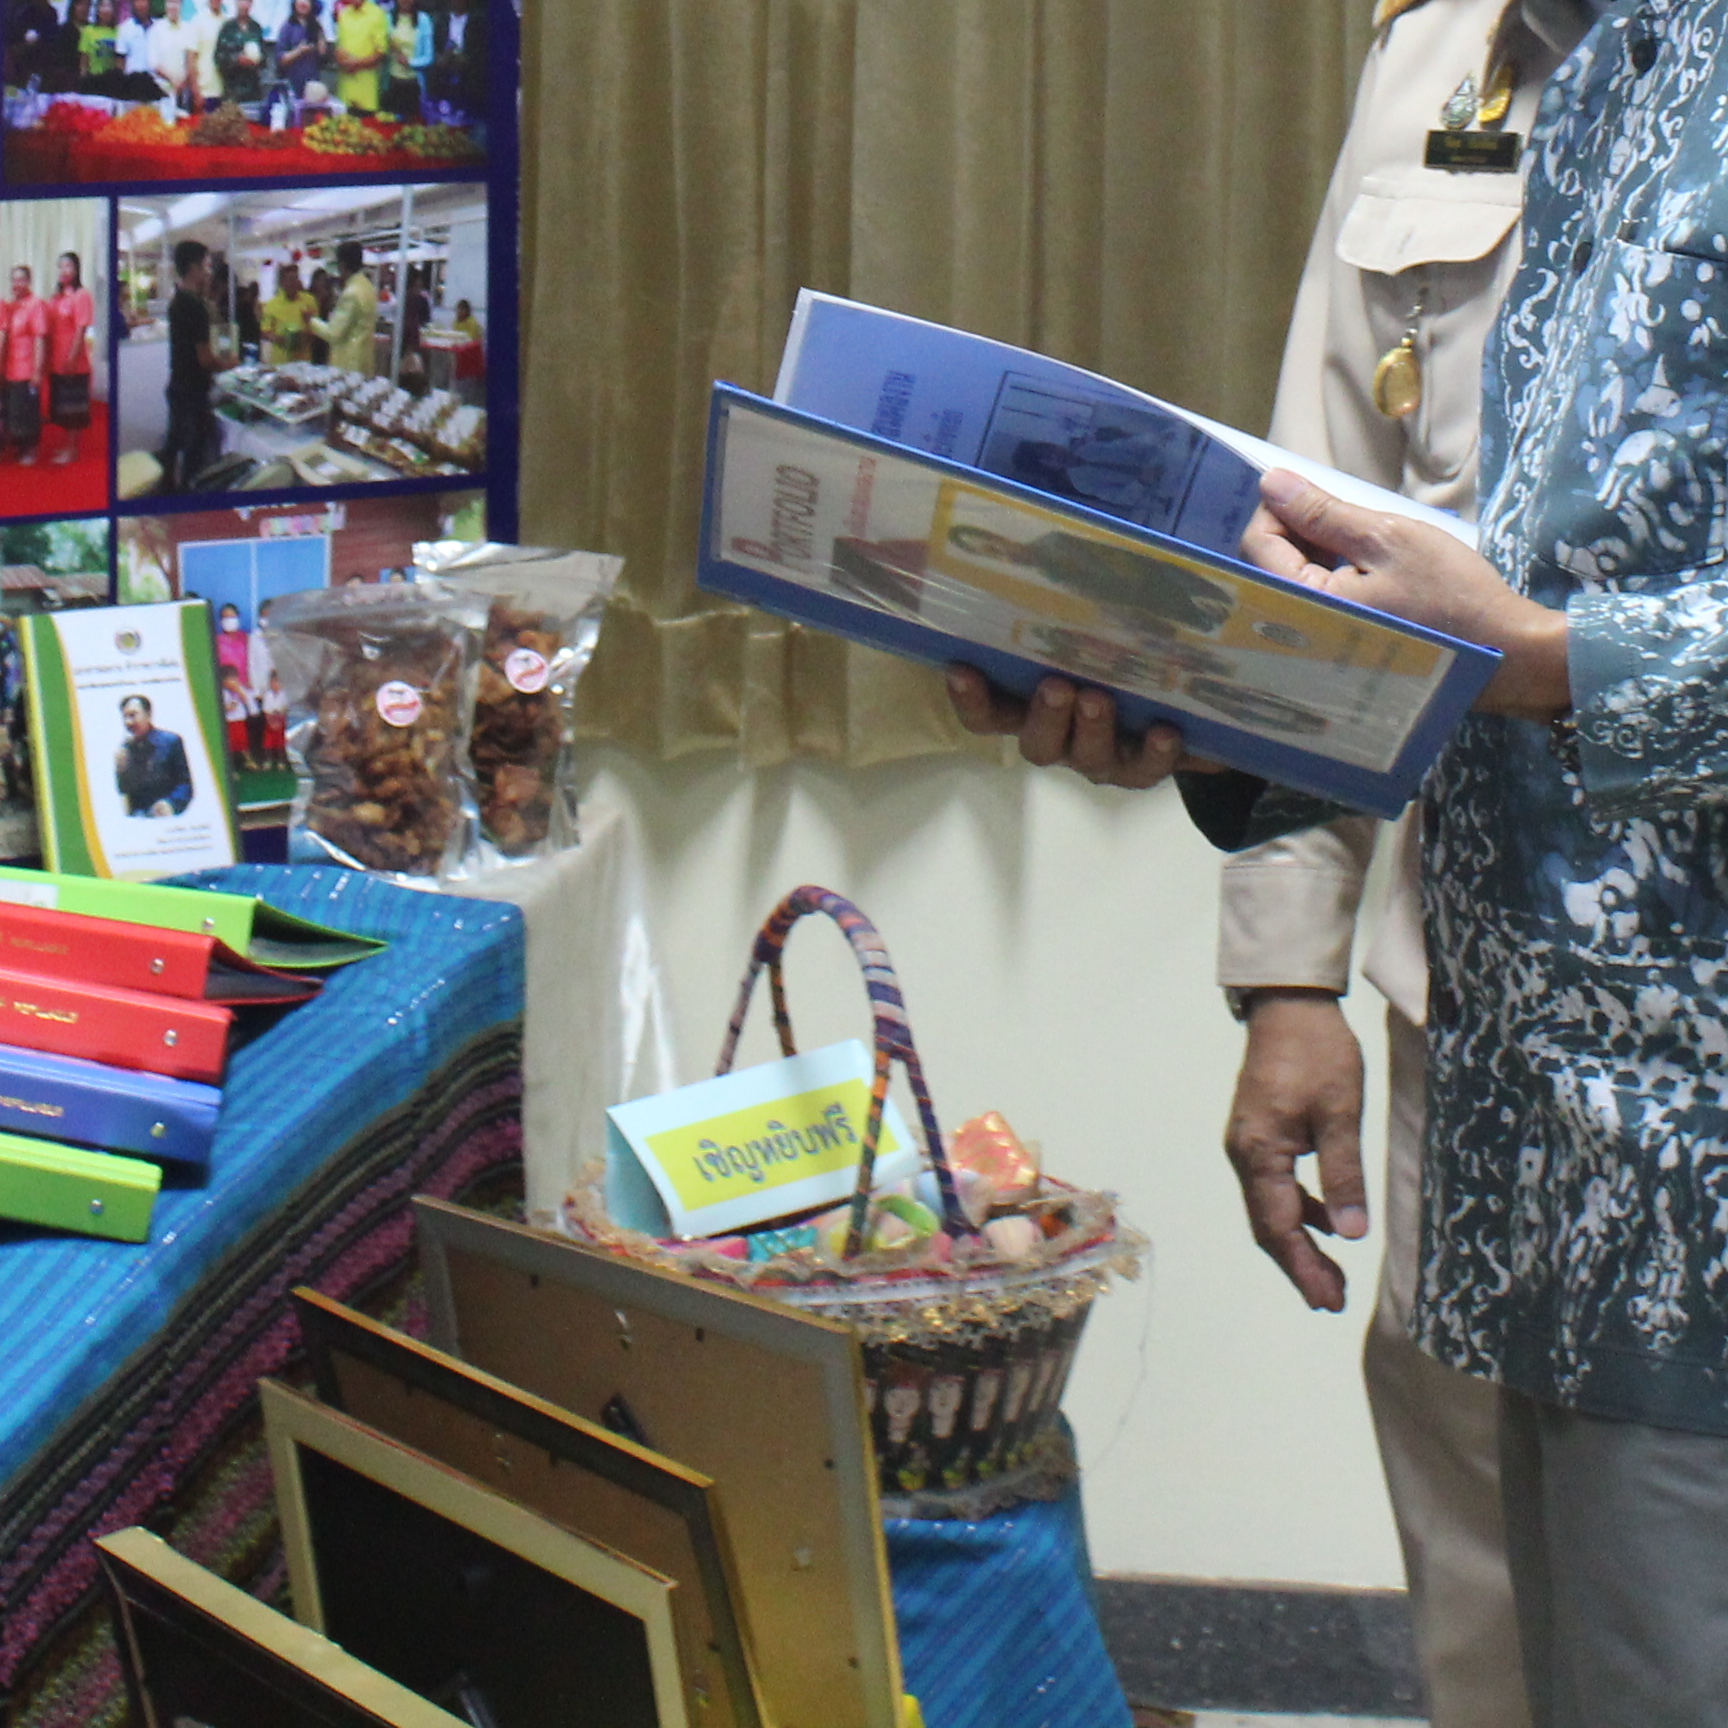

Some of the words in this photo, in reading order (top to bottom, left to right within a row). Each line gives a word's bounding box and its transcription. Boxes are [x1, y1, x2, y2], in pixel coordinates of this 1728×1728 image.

[692, 1101, 859, 1183] เชิญหยิบฟรี
